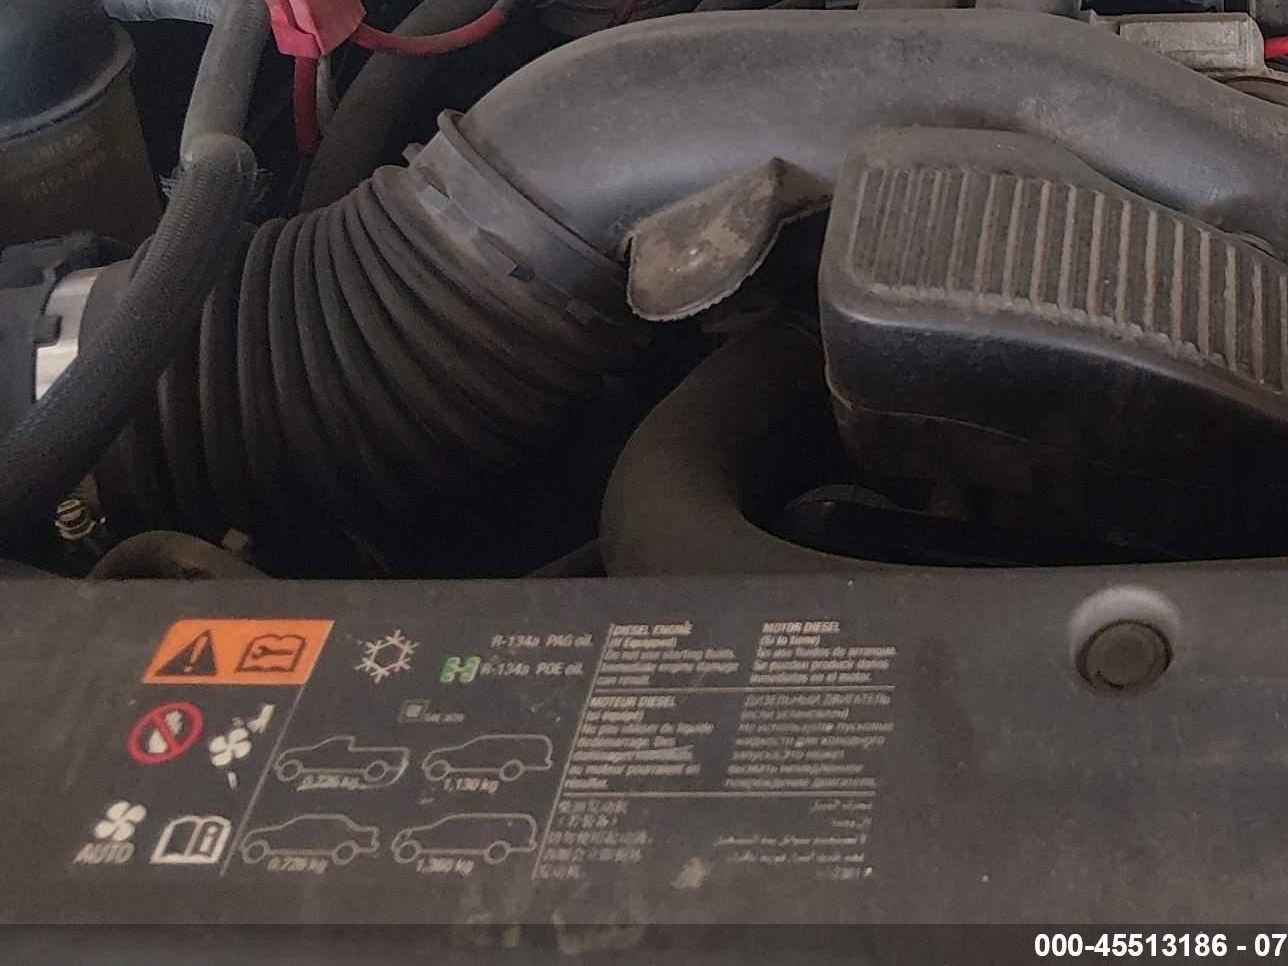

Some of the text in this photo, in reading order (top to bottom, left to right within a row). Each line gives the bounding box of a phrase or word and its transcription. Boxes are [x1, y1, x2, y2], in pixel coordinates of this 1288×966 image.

[762, 622, 840, 633] MOTOR DIESEL
[73, 842, 135, 864] AUTO
